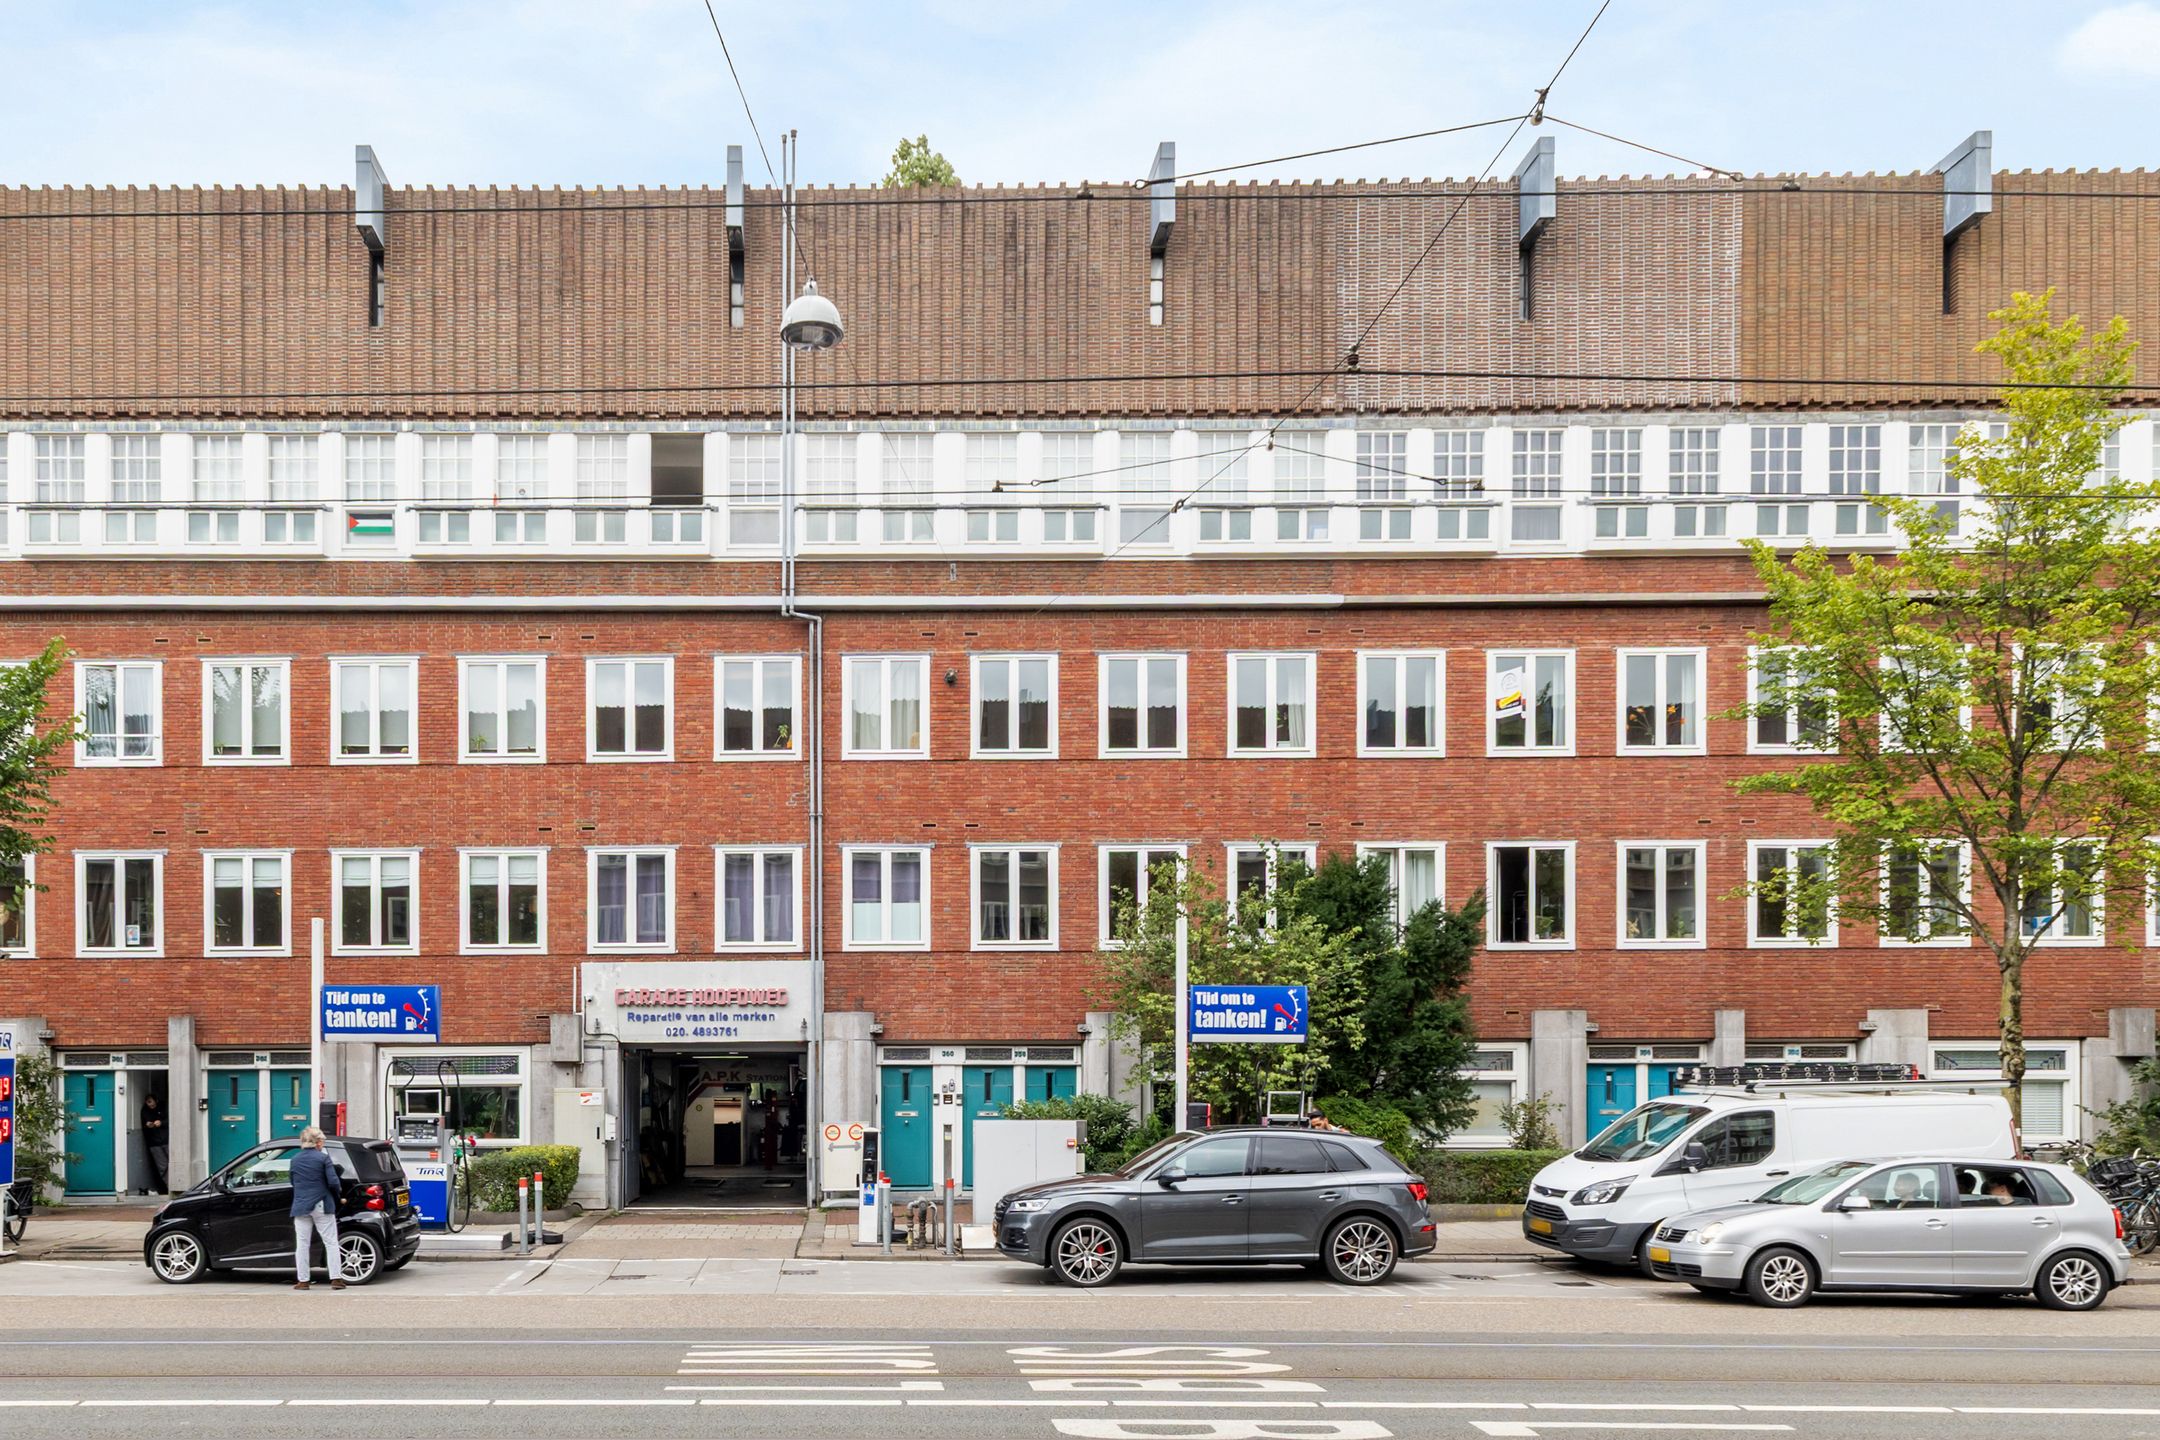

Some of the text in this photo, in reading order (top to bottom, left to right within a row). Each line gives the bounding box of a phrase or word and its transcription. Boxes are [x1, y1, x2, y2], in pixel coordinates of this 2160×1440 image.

[325, 991, 386, 1005] Tijd om te
[615, 988, 790, 1007] GARAGE HOOFDWEG
[1195, 991, 1255, 1006] Tijd om te
[325, 1008, 397, 1028] tanken!
[627, 1012, 775, 1024] Reparatie van alle merken
[1195, 1009, 1267, 1029] tanken!
[665, 1027, 738, 1037] 020. 4893761
[1005, 1346, 1328, 1392] BUS
